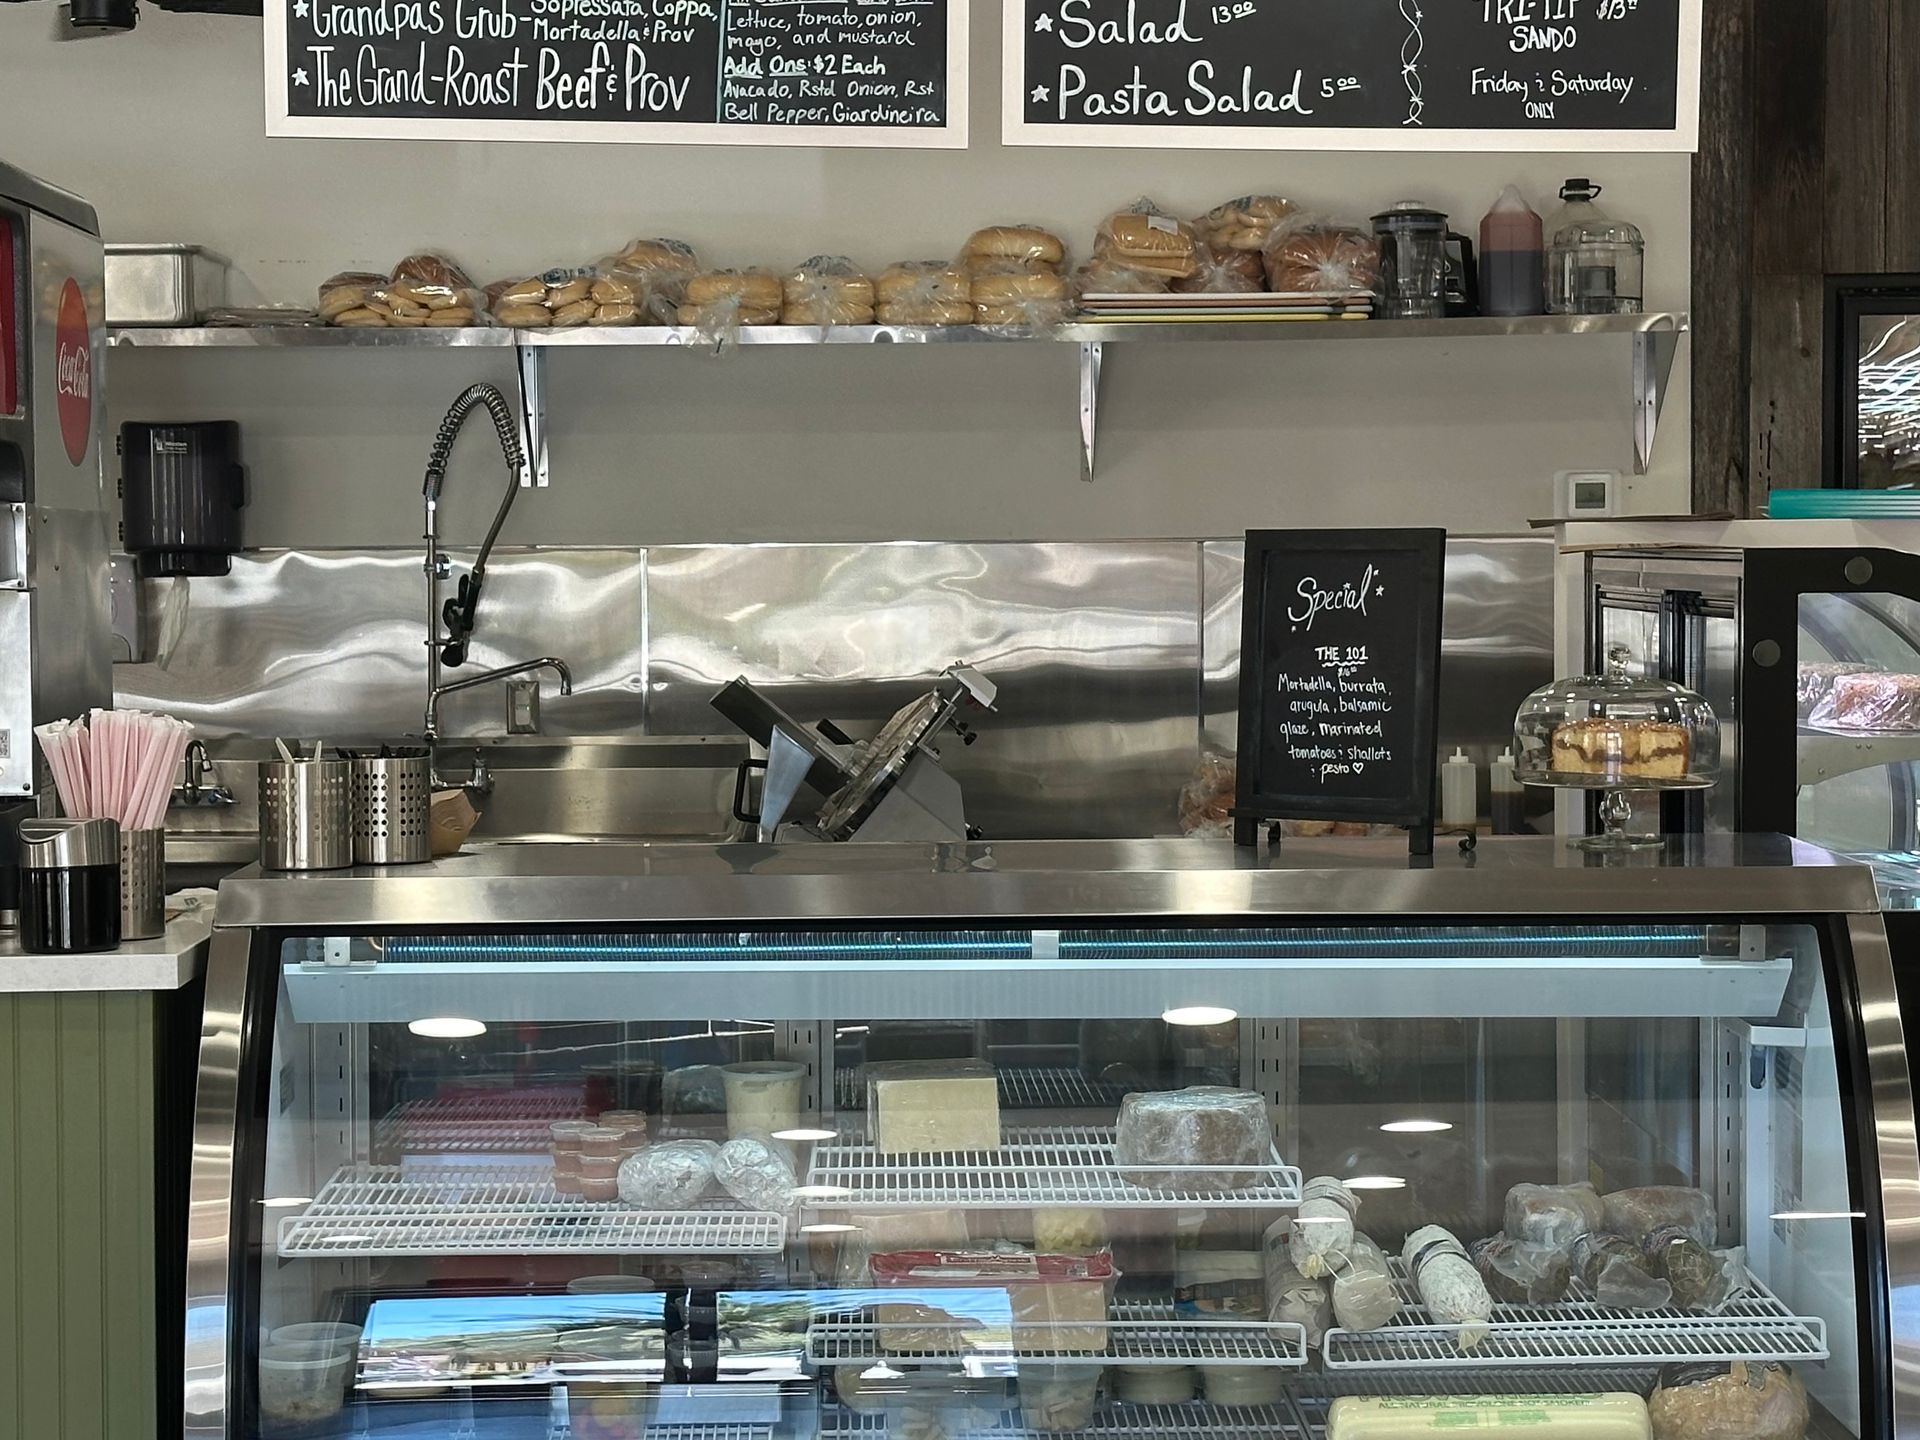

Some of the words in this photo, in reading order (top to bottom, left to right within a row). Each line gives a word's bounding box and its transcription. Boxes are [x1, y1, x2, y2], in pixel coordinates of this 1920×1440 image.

[312, 0, 444, 40] Grandpas
[652, 0, 718, 26] Coppa,
[727, 9, 791, 32] Lettuce,
[797, 5, 864, 28] tomato,
[865, 10, 923, 28] onion,
[1058, 0, 1204, 48] Salad
[533, 17, 640, 42] Mortadella
[652, 19, 695, 43] Prov
[727, 35, 782, 56] mayo,
[793, 29, 831, 44] and
[838, 29, 916, 46] mustard
[1509, 25, 1577, 53] SANDO
[306, 45, 351, 108] The
[356, 41, 529, 108] Grand-Roast
[536, 41, 611, 111] Beef
[625, 43, 691, 112] Prov
[723, 55, 764, 77] Add
[769, 56, 812, 76] Ons:
[813, 54, 838, 75] $2
[841, 55, 887, 75] Each
[723, 80, 793, 99] Avacado,
[799, 80, 837, 99] Rstd
[847, 81, 899, 99] Onion,
[904, 80, 935, 96] Rst
[1058, 63, 1179, 120] Pasta
[1184, 59, 1314, 116] Salad
[1471, 67, 1528, 102] Friday
[1551, 69, 1634, 104] Saturday
[724, 102, 758, 121] Bell
[767, 103, 830, 124] Pepper,
[832, 102, 941, 123] Giardineira
[1525, 101, 1555, 119] ONLY
[1287, 563, 1372, 632] Special
[1314, 646, 1340, 661] THE
[1345, 645, 1369, 661] 101
[1277, 673, 1337, 693] Mortadella,
[1339, 675, 1393, 696] burrata,
[1339, 697, 1393, 713] balsamic
[1279, 721, 1315, 744] glaze,
[1319, 720, 1383, 738] marinated
[1287, 745, 1337, 761] tomatoes
[1347, 745, 1393, 762] shallots
[1319, 762, 1350, 784] pesto
